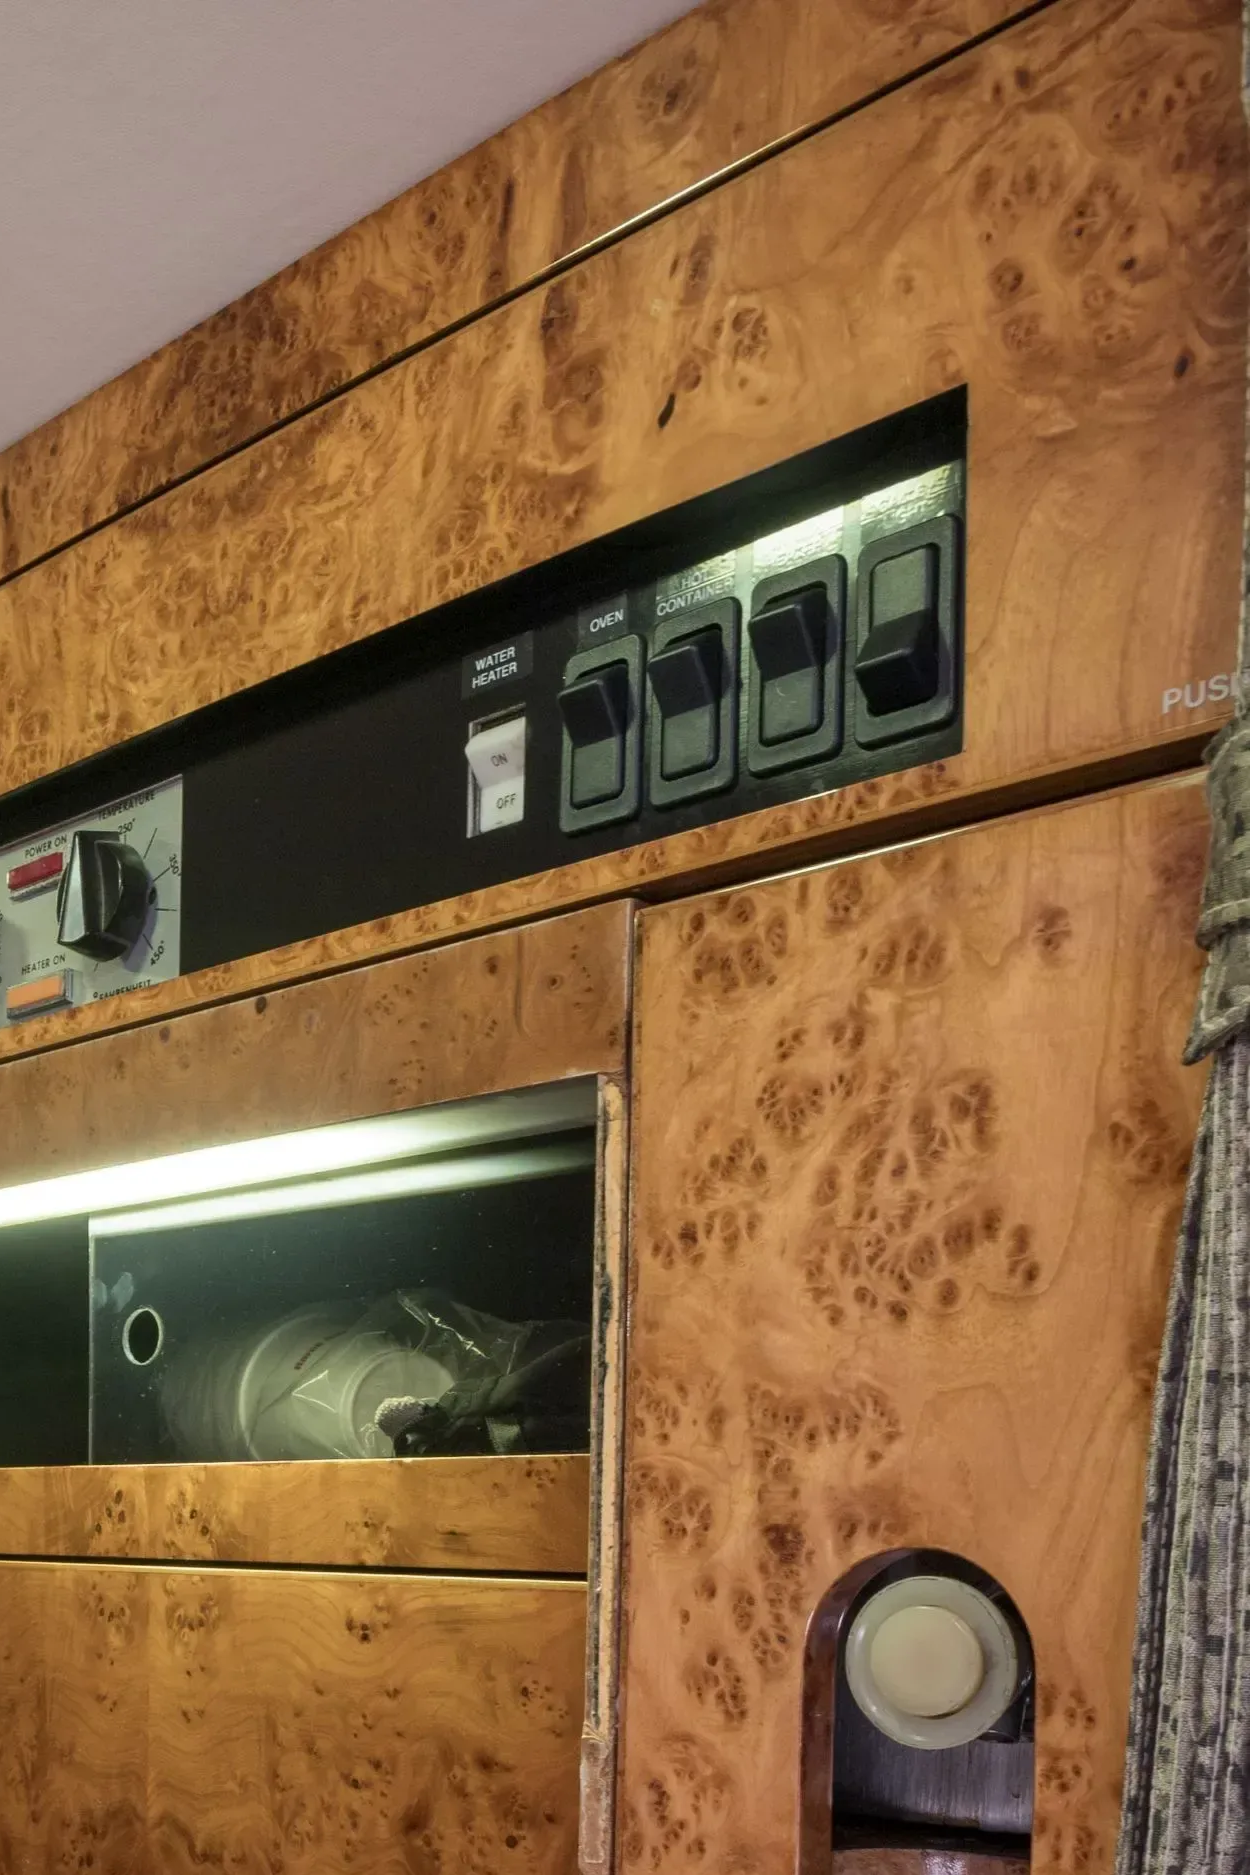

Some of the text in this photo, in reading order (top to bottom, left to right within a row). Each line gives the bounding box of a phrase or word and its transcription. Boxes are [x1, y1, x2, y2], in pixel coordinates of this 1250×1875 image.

[681, 571, 707, 590] HOT
[656, 577, 734, 616] CONTAINER
[589, 609, 625, 632] OVEN
[475, 646, 516, 671] WATER
[472, 661, 518, 689] HEATER
[491, 753, 509, 767] ON
[496, 793, 517, 810] OFF
[24, 834, 68, 859] POWER ON
[21, 953, 67, 976] HEATER ON
